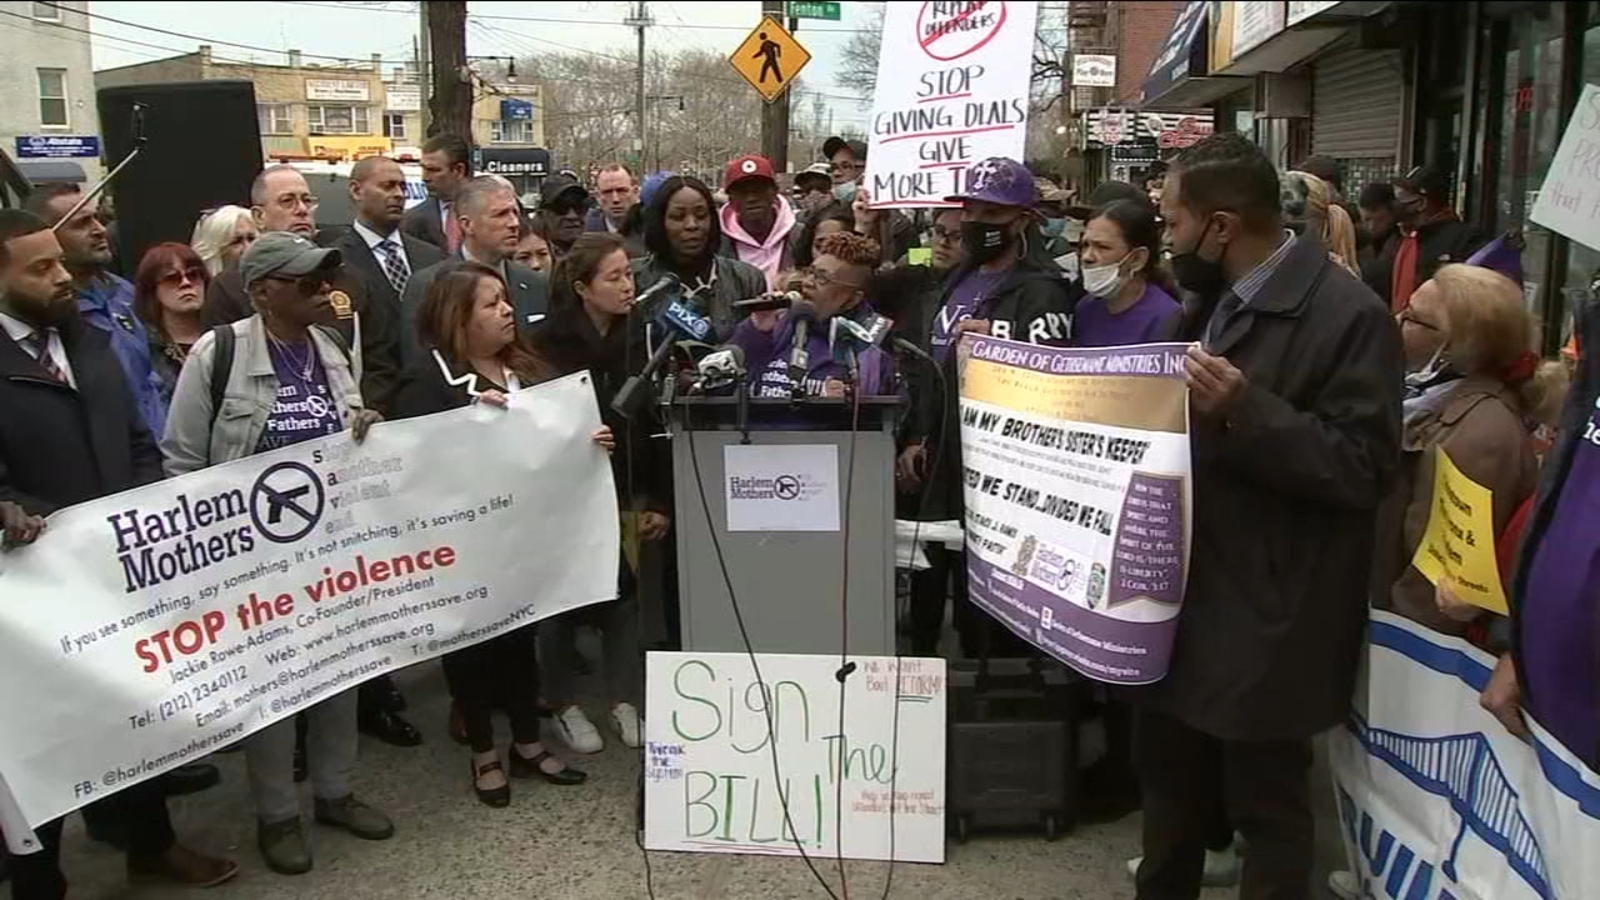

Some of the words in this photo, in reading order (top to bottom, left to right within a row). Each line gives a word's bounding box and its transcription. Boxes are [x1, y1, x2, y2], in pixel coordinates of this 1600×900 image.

[916, 65, 985, 97] STOP
[874, 106, 951, 135] GIVING
[919, 136, 973, 162] GIVE
[487, 160, 543, 172] Cleaners
[874, 171, 940, 201] MORE
[973, 340, 1028, 365] GARDEN
[1030, 354, 1051, 369] OF
[267, 416, 321, 431] Fathers
[979, 408, 1000, 433] MY
[730, 476, 773, 489] Harlem
[730, 488, 774, 500] Mothers
[981, 472, 1003, 497] WE
[106, 488, 248, 553] Harlem
[60, 635, 71, 654] If
[75, 632, 98, 653] you
[100, 622, 118, 638] see
[121, 594, 195, 629] something,
[200, 584, 220, 601] say
[223, 557, 292, 590] something.
[295, 549, 315, 563] It's
[318, 541, 338, 557] not
[341, 522, 402, 547] snitching,
[407, 517, 428, 531] it's
[432, 506, 476, 528] saving
[479, 505, 487, 516] a
[490, 493, 514, 511] life!
[119, 525, 254, 593] Mothers
[135, 610, 225, 673] STOP
[237, 592, 294, 631] the
[304, 545, 456, 603] violence
[169, 658, 208, 685] Jackie
[129, 711, 155, 731] Tel:
[159, 693, 193, 721] (212)
[265, 646, 300, 667] Web:
[196, 700, 232, 728] Email:
[672, 659, 810, 754] Sign
[74, 780, 98, 799] FB:
[102, 720, 245, 786] @harlemmotherssave
[822, 734, 893, 785] The
[686, 771, 823, 849] BILL!
